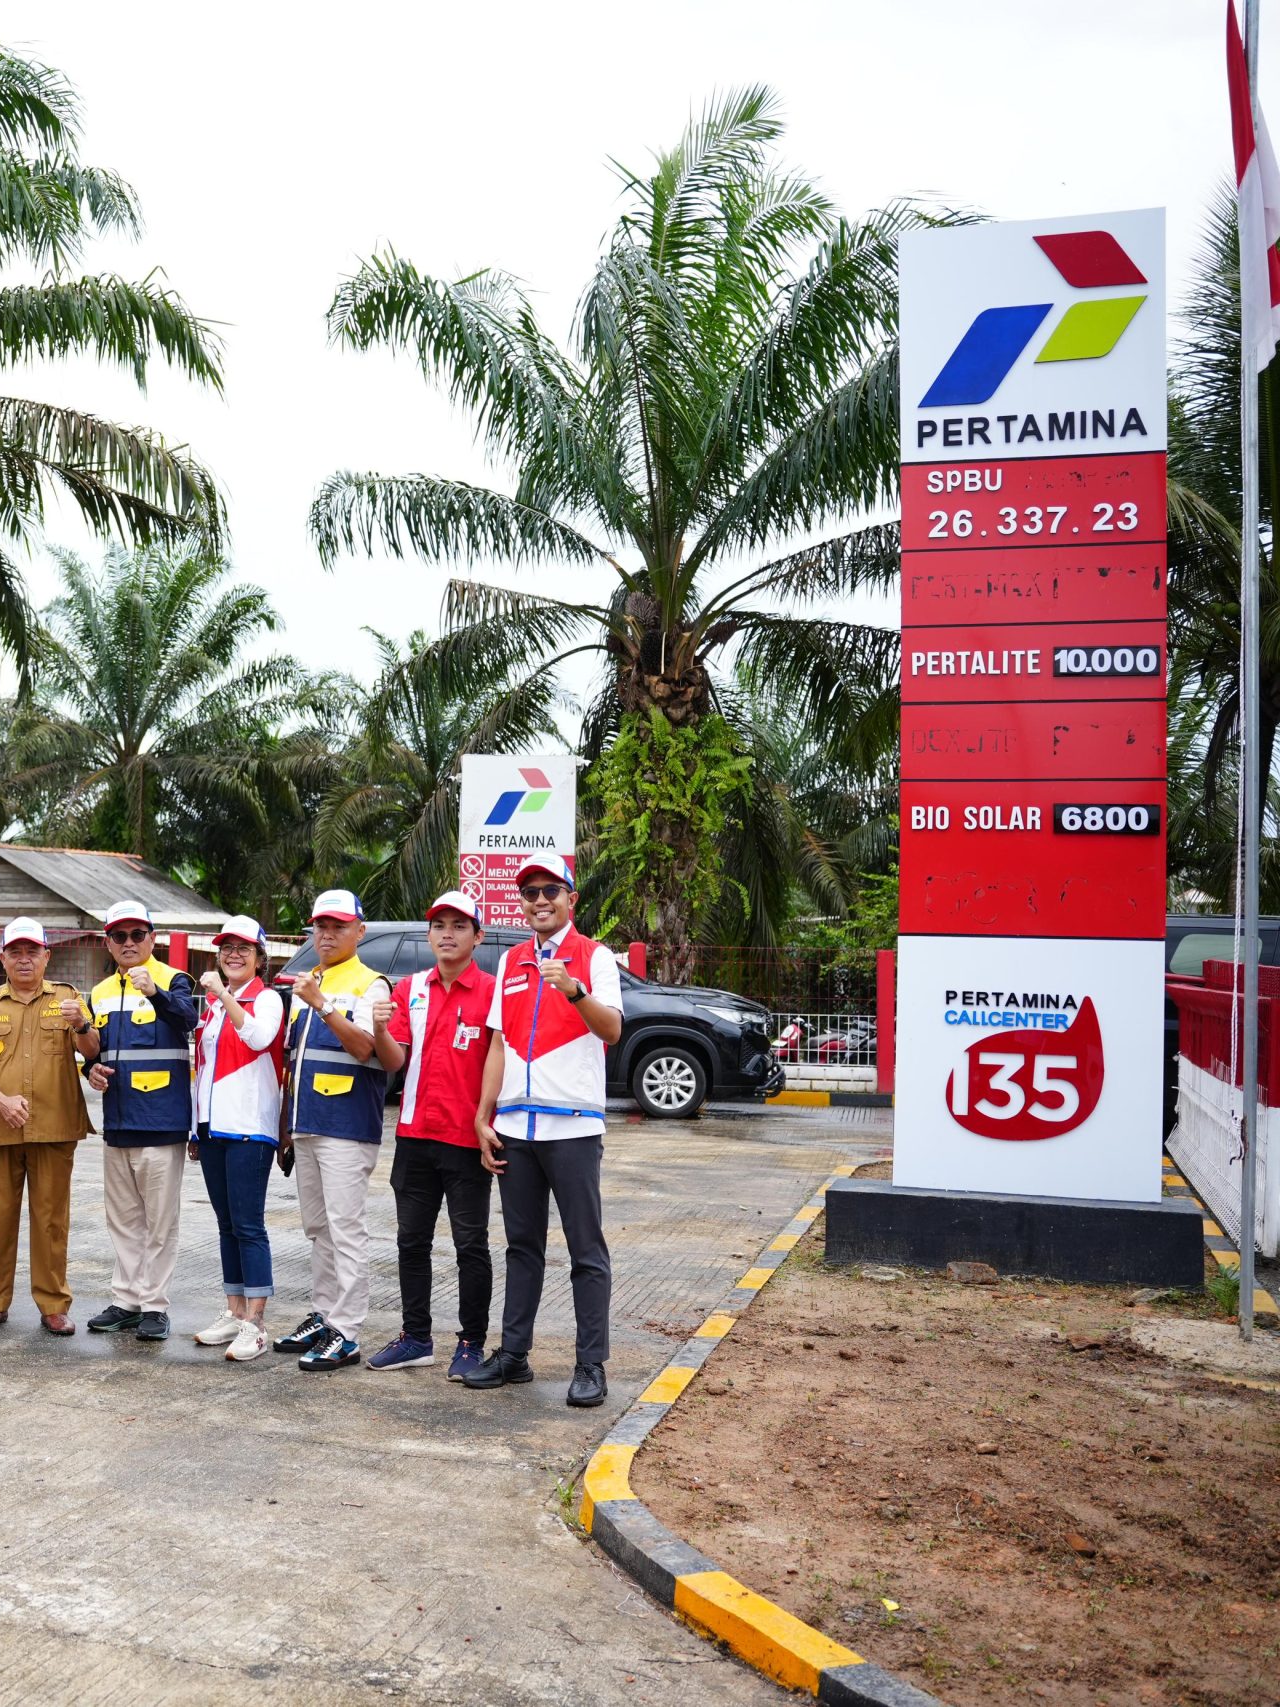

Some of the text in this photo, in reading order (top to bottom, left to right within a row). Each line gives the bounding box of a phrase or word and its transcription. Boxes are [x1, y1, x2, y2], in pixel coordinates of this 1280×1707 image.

[917, 408, 1148, 448] PERTAMINA
[911, 648, 1158, 676] PERTALITE 10.000
[911, 805, 1150, 832] BIO SOLAR 6800
[478, 834, 556, 848] PERTAMINA
[945, 990, 1078, 1010] PERTAMINA
[944, 1010, 1069, 1029] CALLCENTER
[951, 1051, 1080, 1123] 135
